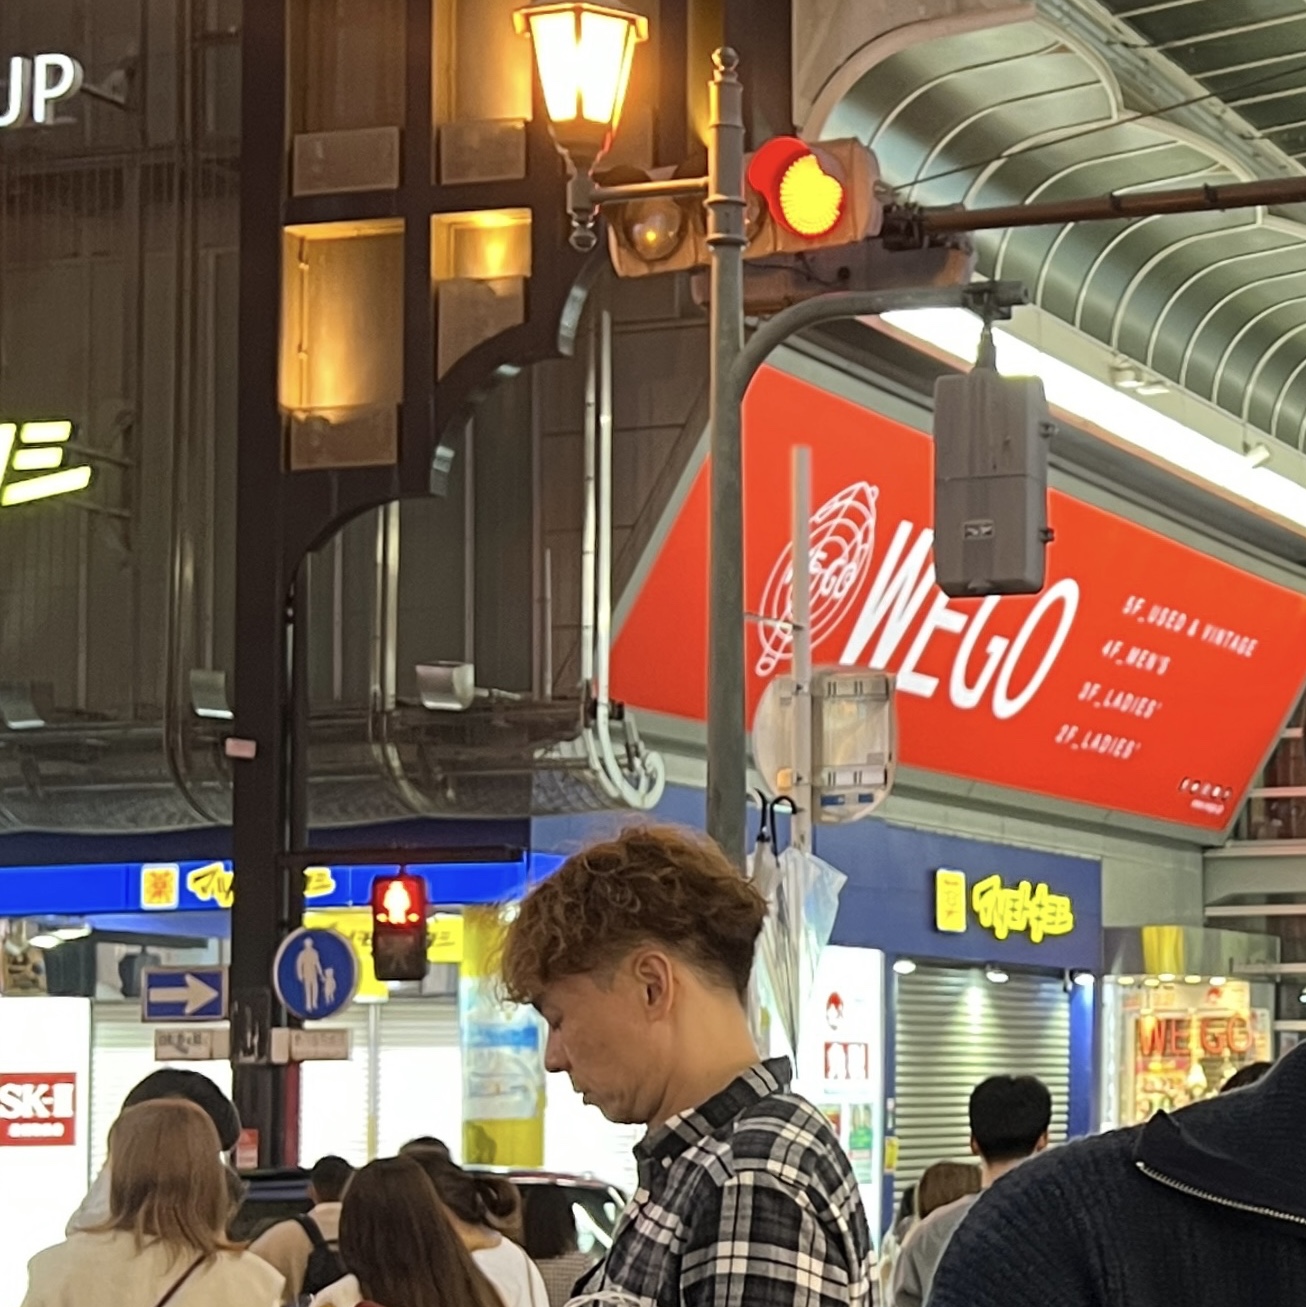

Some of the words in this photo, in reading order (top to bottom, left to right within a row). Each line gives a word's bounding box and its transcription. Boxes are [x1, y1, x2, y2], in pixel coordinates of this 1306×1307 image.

[839, 520, 1079, 719] WEGO
[1187, 618, 1200, 637] &
[1200, 623, 1258, 657] VINTAGE
